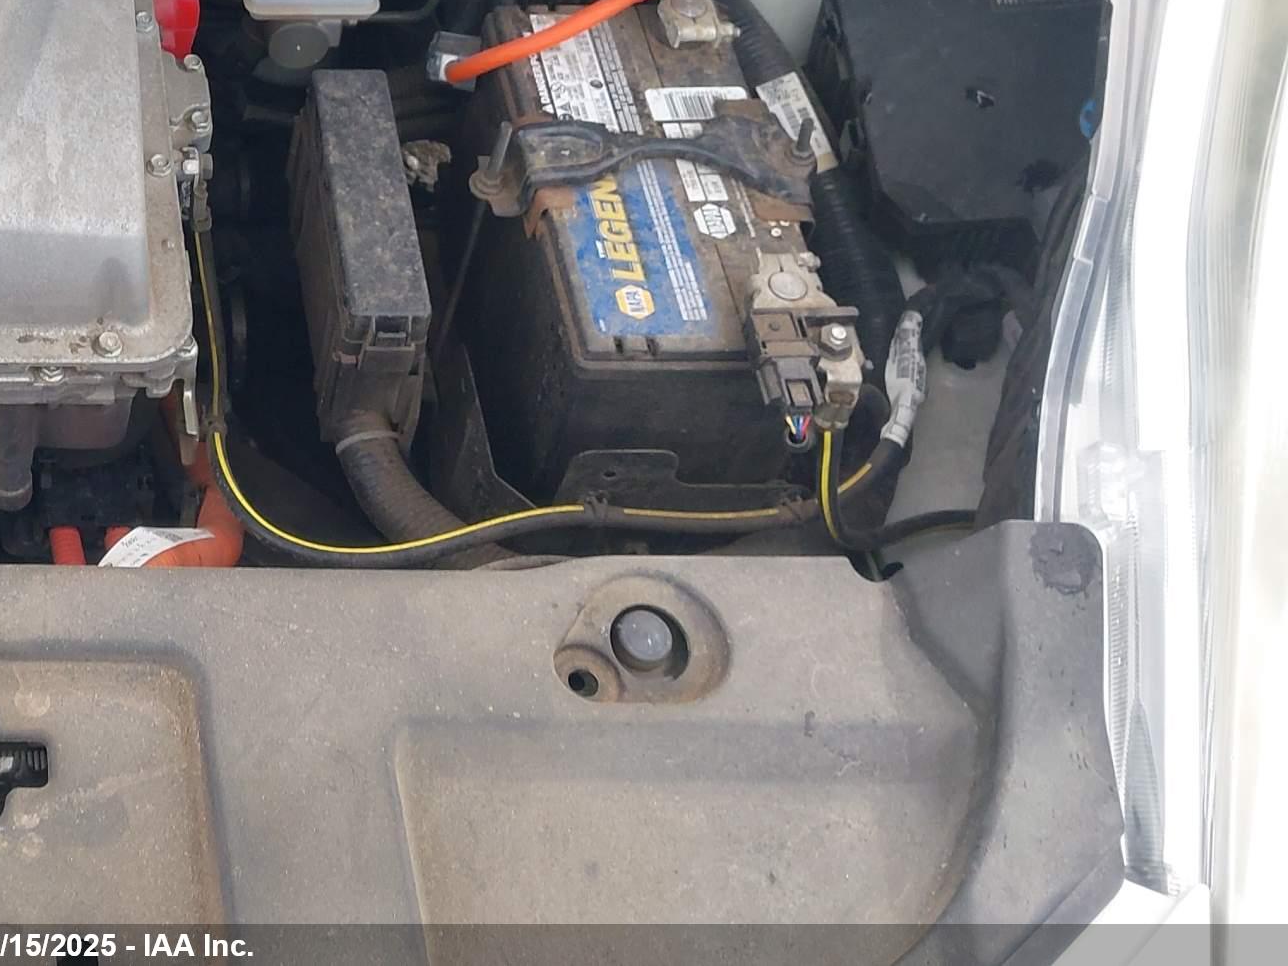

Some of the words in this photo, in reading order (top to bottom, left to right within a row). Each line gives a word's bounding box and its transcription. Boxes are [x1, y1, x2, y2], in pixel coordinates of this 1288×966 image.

[589, 173, 646, 282] LEGEN
[704, 207, 727, 234] NAPA
[624, 289, 646, 313] NAPA
